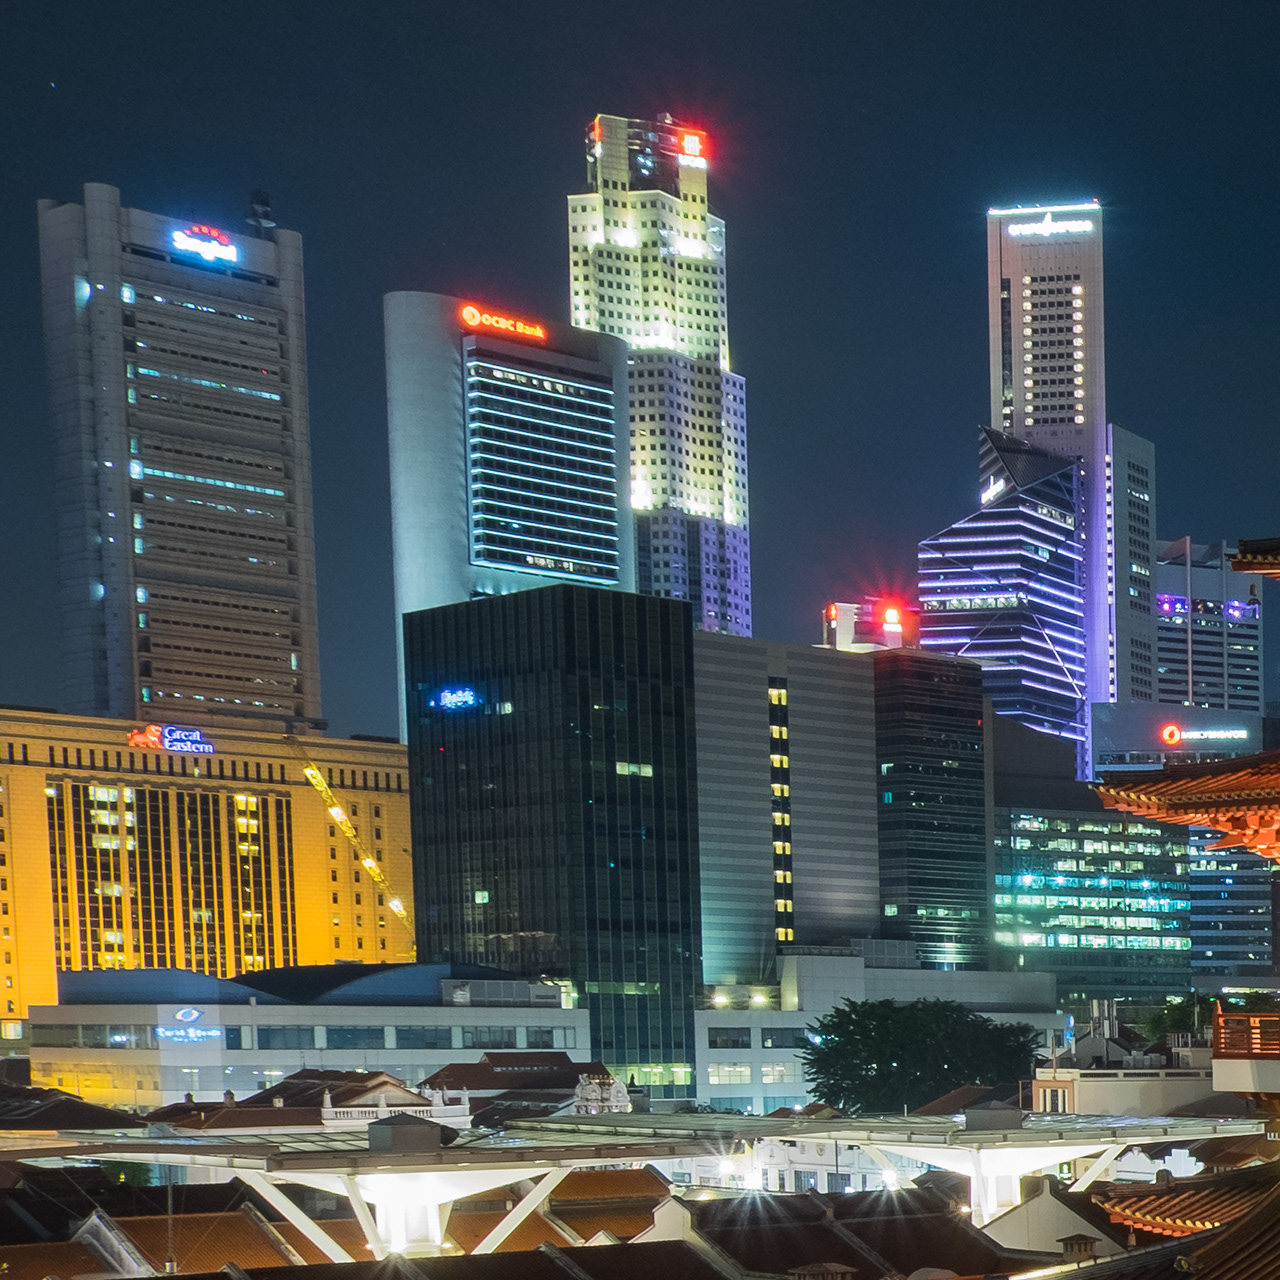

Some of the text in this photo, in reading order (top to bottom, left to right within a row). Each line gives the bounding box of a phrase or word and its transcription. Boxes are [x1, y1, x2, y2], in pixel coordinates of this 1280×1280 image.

[480, 314, 545, 338] OCBC Bank
[164, 726, 202, 741] Great
[163, 737, 215, 753] Eastern
